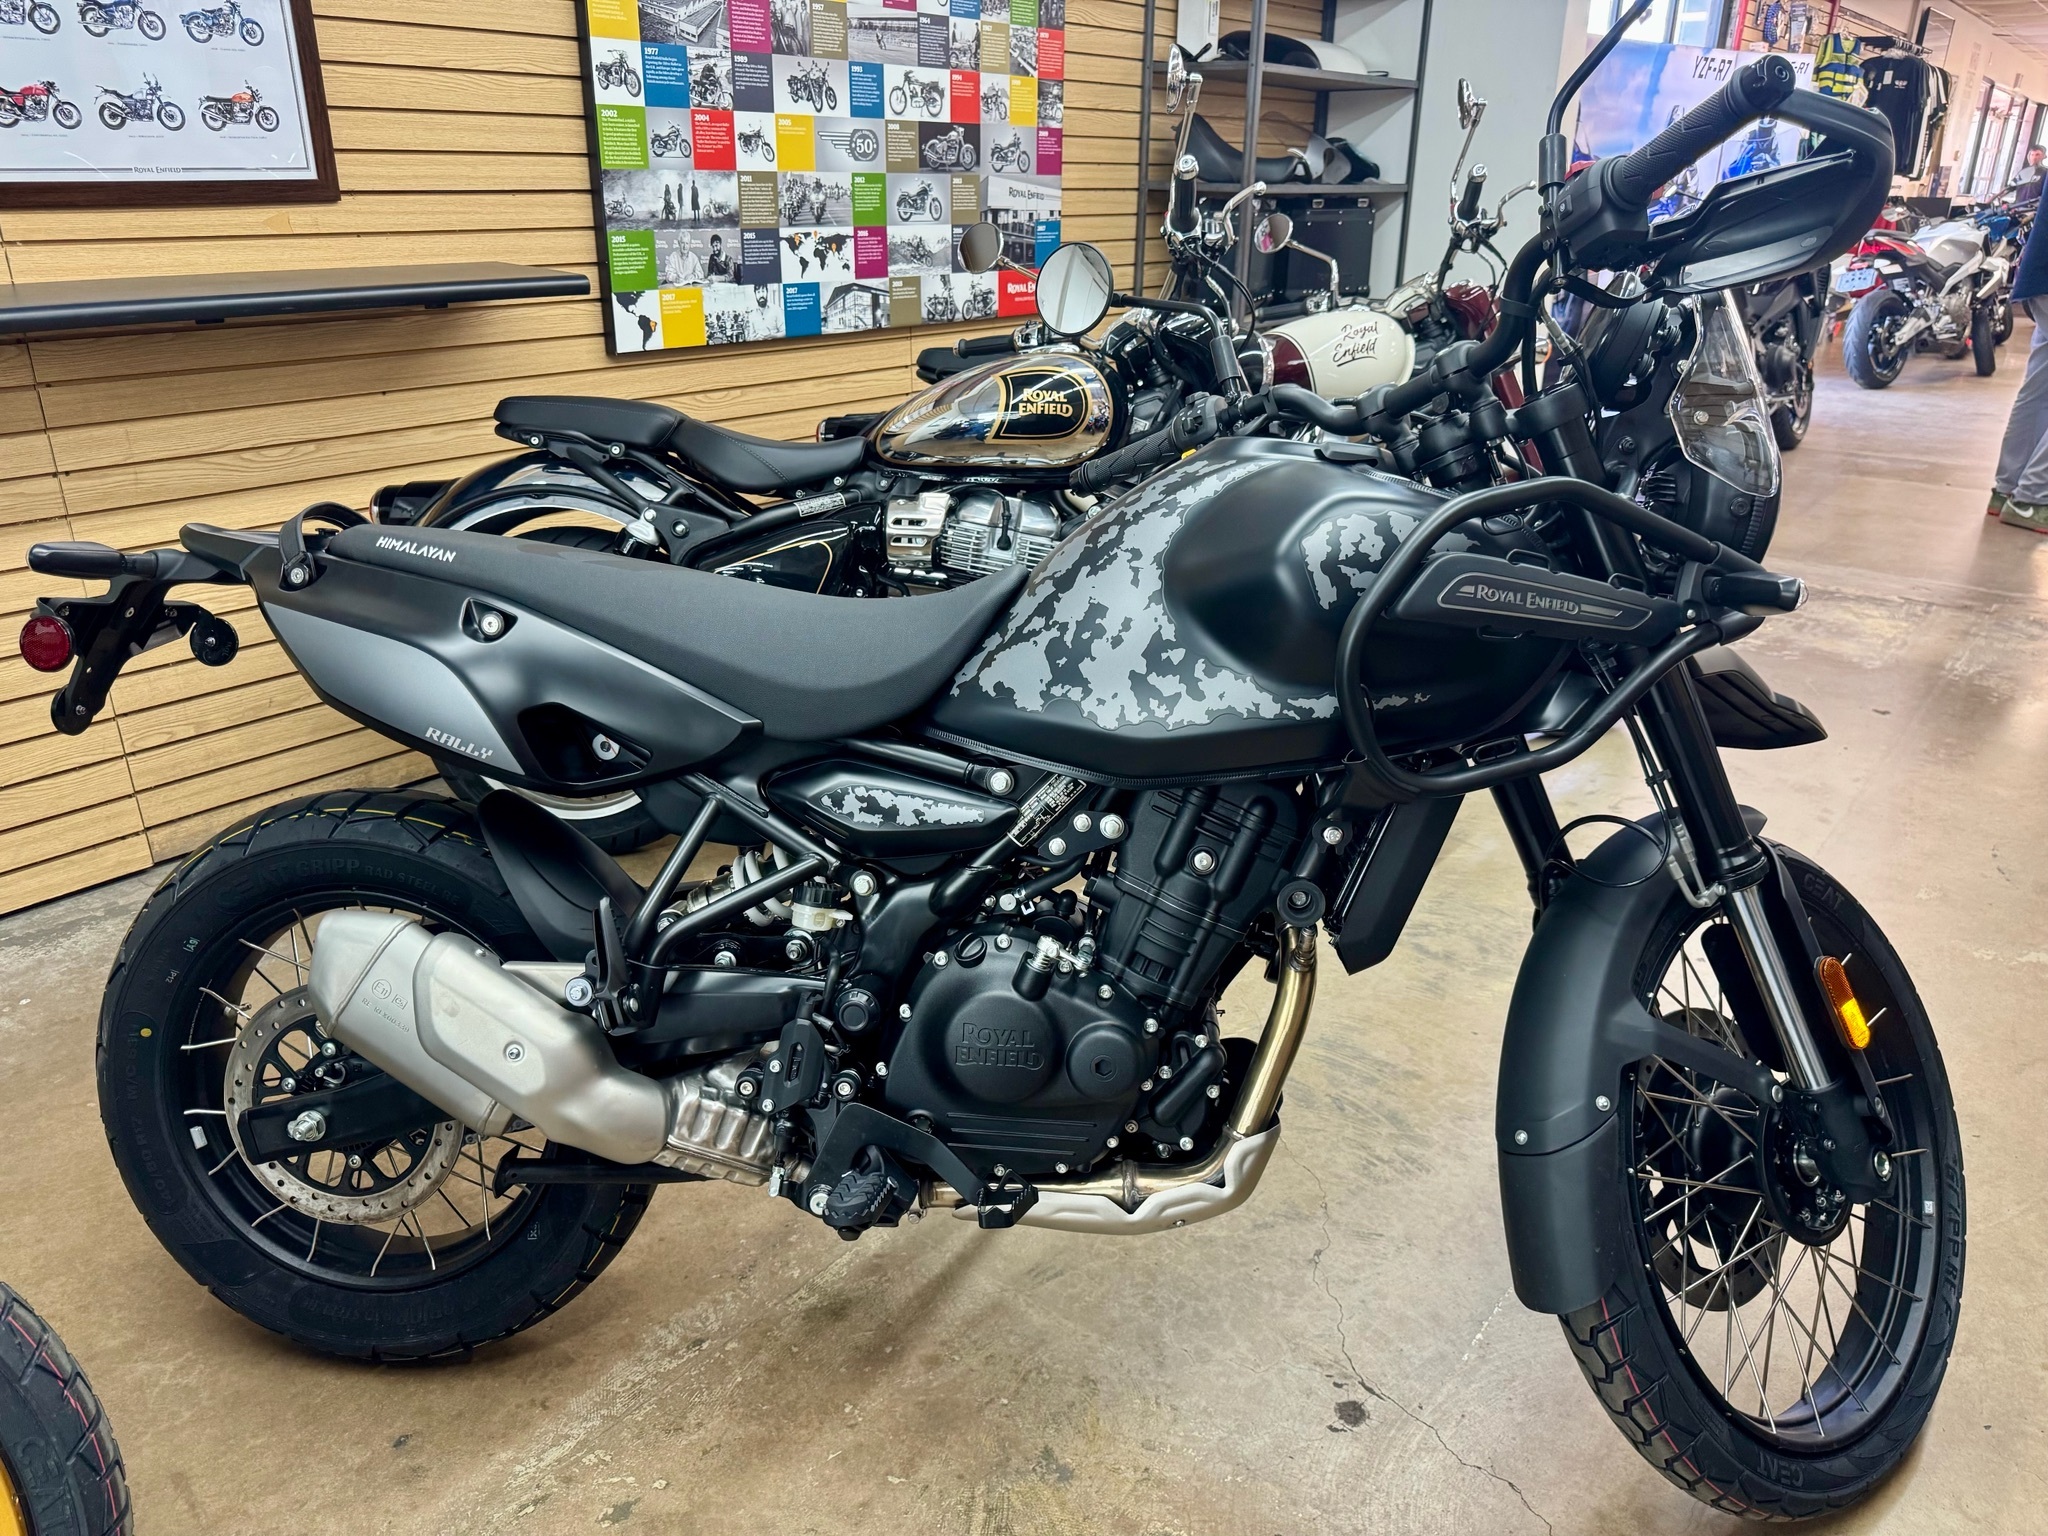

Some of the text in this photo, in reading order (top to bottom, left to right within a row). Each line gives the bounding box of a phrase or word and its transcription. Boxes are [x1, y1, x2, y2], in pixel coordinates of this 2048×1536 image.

[920, 16, 930, 24] 1964
[644, 47, 658, 55] 1977
[734, 55, 748, 63] 1989
[1692, 55, 1732, 82] YZF-R7
[778, 118, 792, 126] 2005
[856, 138, 873, 153] 50
[133, 166, 182, 174] ROYAL ENFIELD
[1009, 186, 1045, 200] ROYAL ENFIELD
[611, 235, 626, 243] 2015
[1007, 282, 1027, 294] ROYAL
[662, 293, 676, 301] 2017
[1341, 321, 1379, 342] Royal
[1333, 338, 1376, 362] Enfield
[1022, 388, 1068, 403] ROYAL
[1018, 402, 1073, 418] ENFIELD
[376, 536, 456, 563] HIMALAYAN
[1476, 584, 1579, 615] ROYAL ENFIELD
[425, 726, 493, 760] RALLY
[295, 858, 361, 877] GRIPP
[962, 1022, 1035, 1048] ROYAL
[955, 1046, 1045, 1070] ENFIELD
[1757, 1452, 1803, 1487] CEAT
